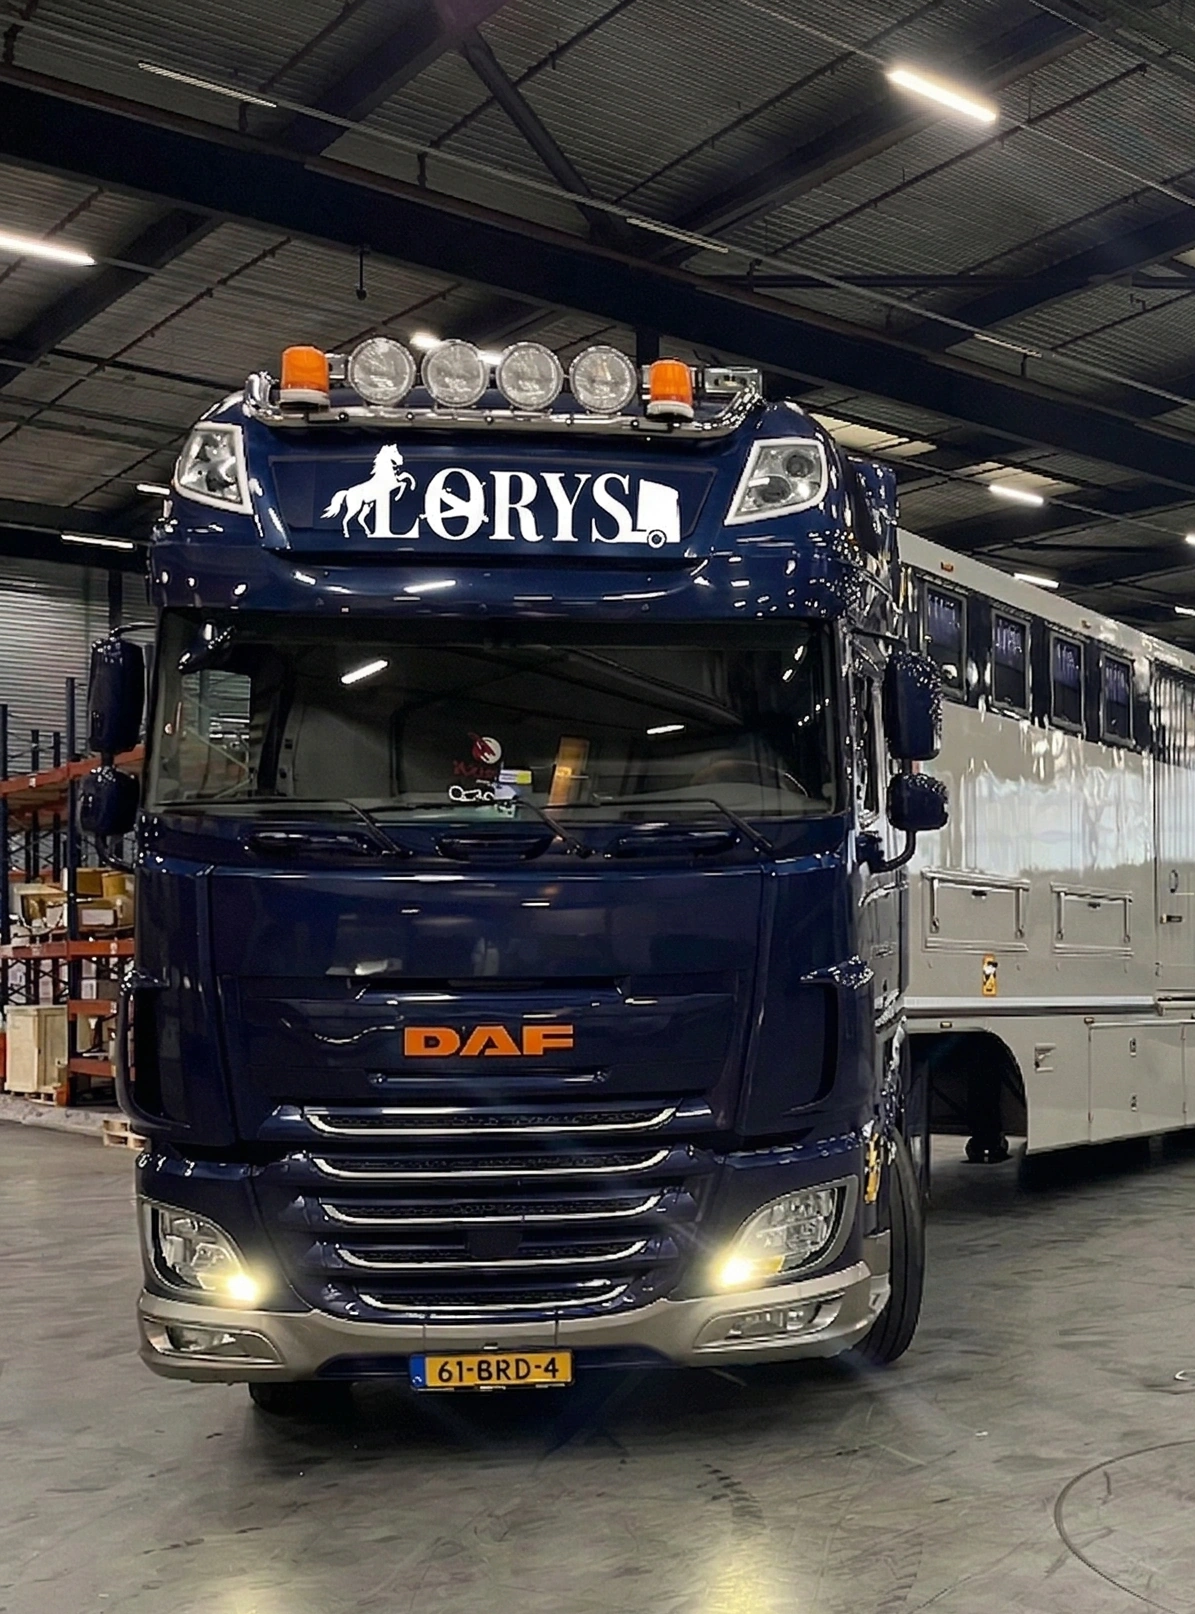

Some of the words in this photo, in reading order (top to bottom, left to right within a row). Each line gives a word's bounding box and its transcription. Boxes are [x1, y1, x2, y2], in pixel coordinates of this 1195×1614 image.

[366, 467, 636, 543] LORYS
[404, 1025, 574, 1056] DAF
[438, 1357, 559, 1383] 61-BRD-4
